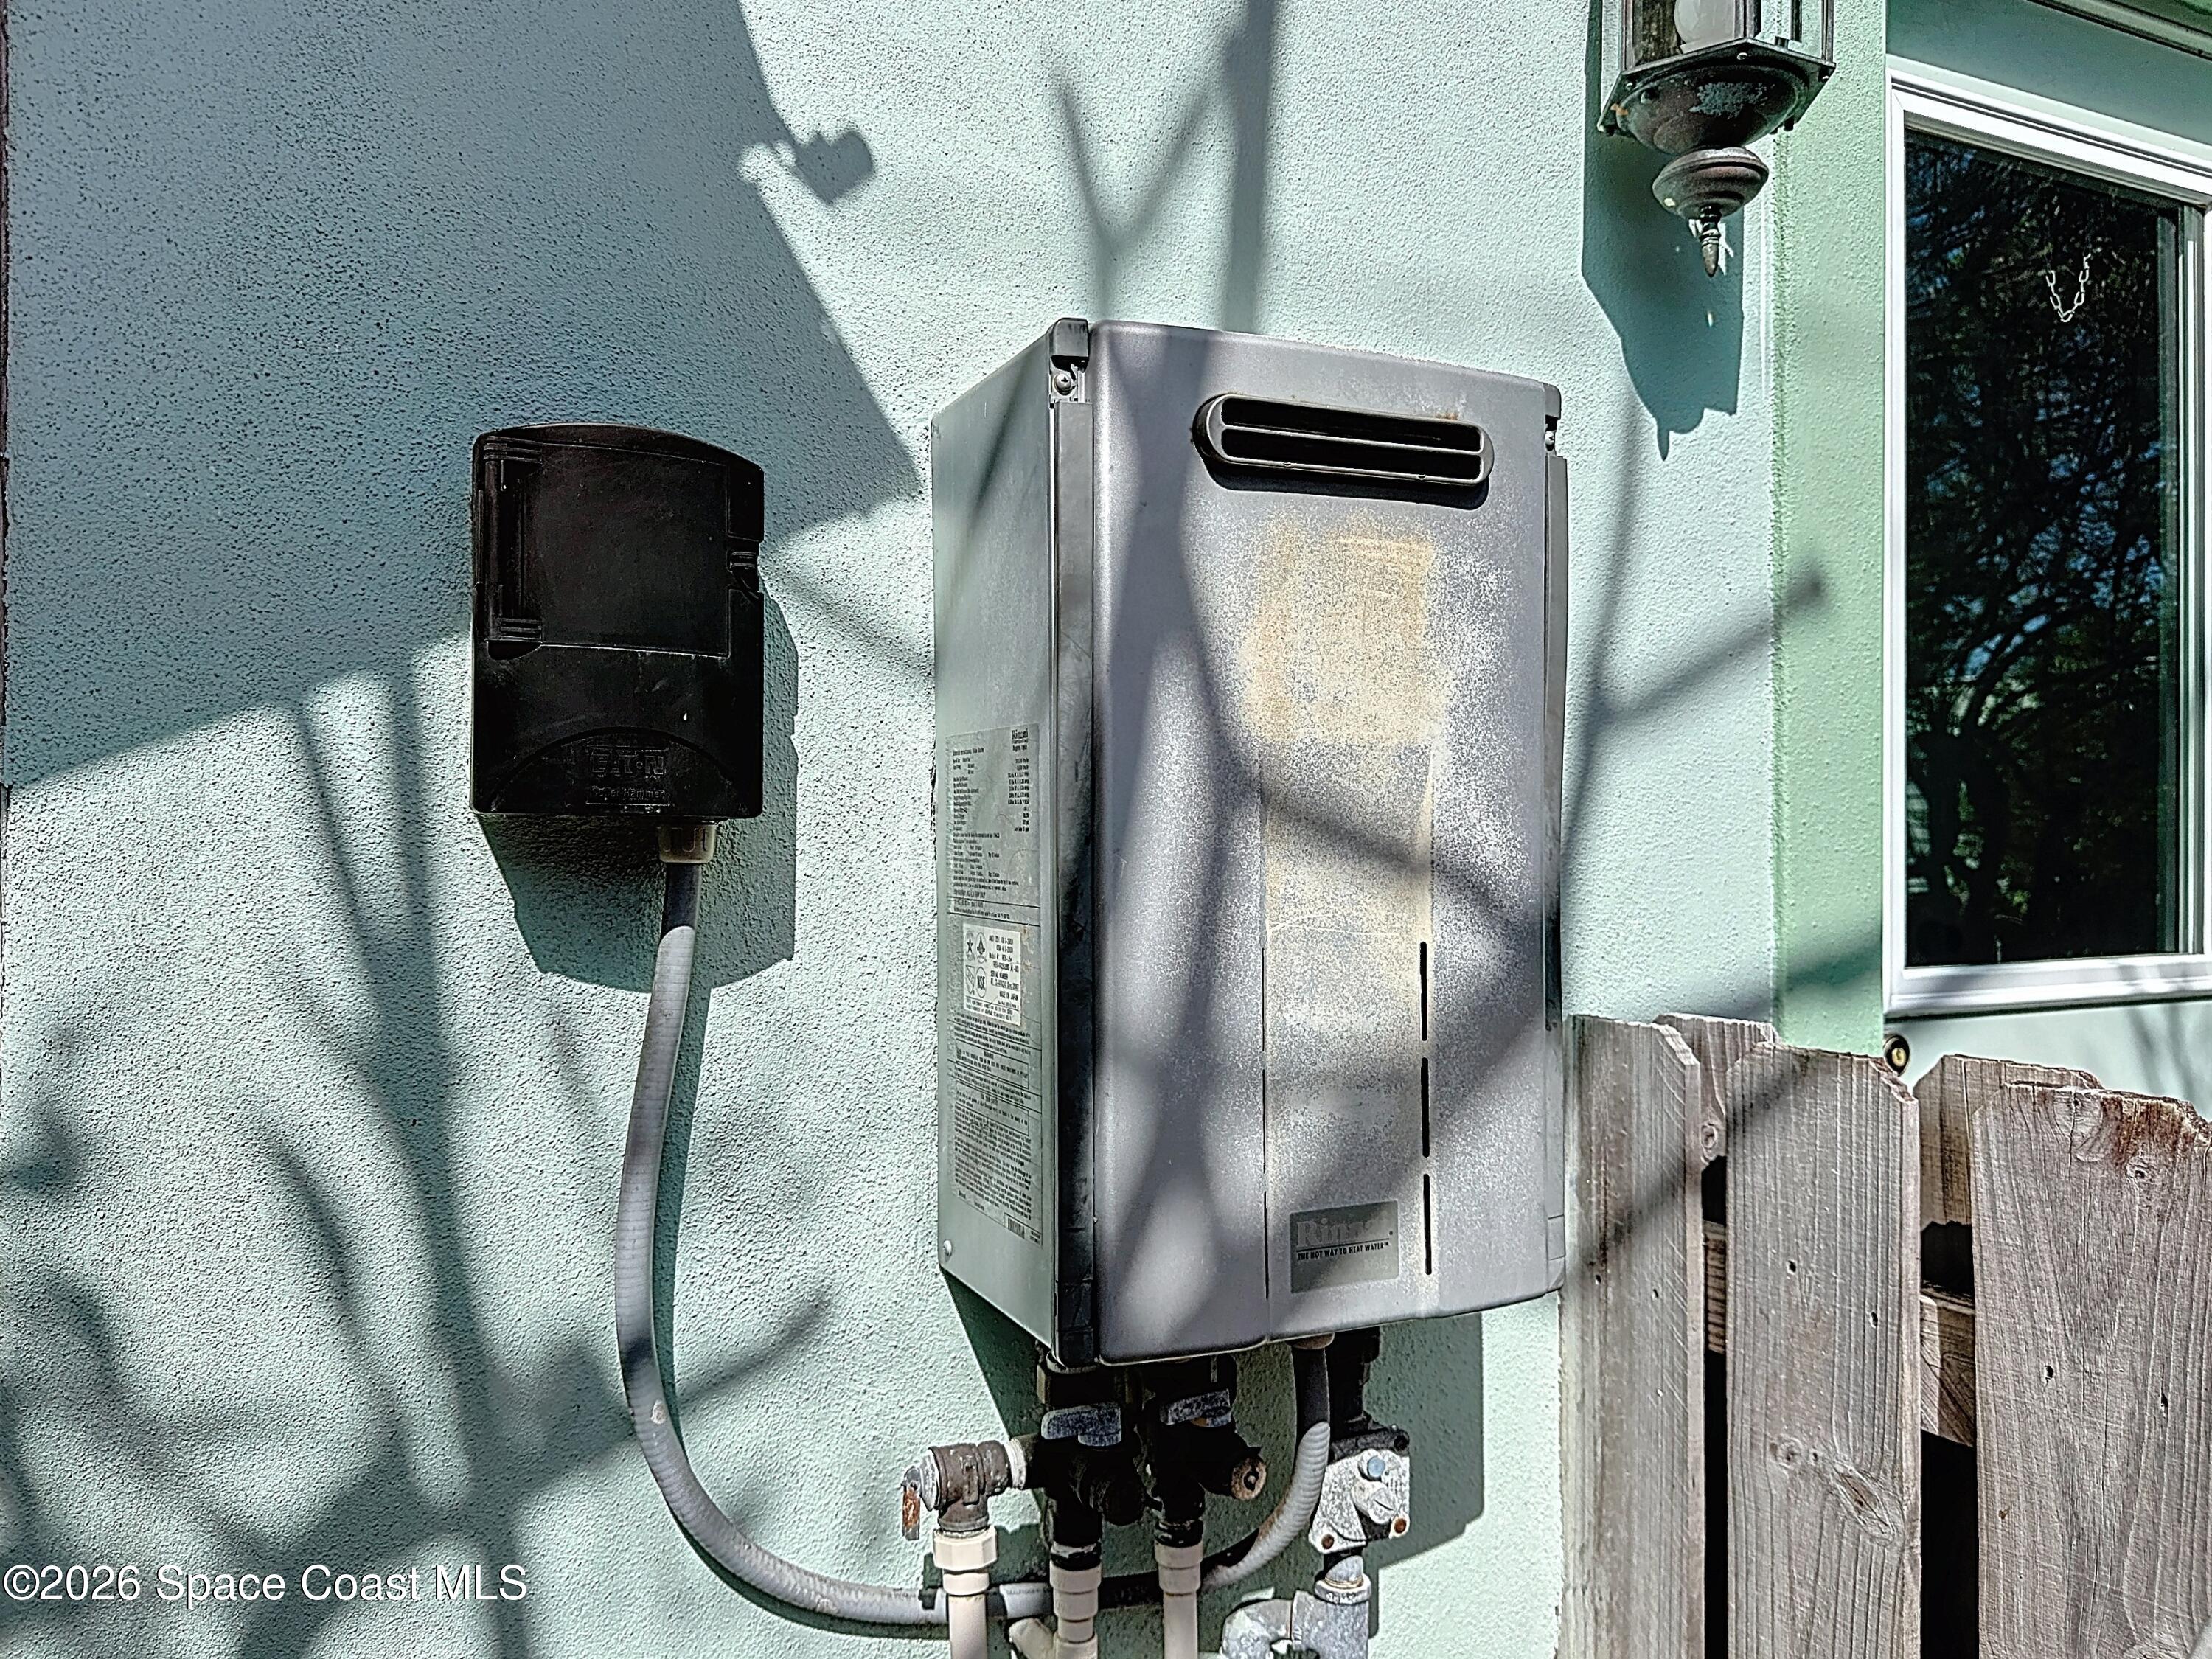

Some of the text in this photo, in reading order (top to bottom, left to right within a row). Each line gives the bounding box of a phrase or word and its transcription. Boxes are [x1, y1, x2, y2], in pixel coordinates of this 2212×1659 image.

[1297, 1252, 1309, 1261] THE
[1324, 1249, 1338, 1257] WAY
[1339, 1247, 1347, 1255] TO
[1349, 1245, 1363, 1253] HEAT
